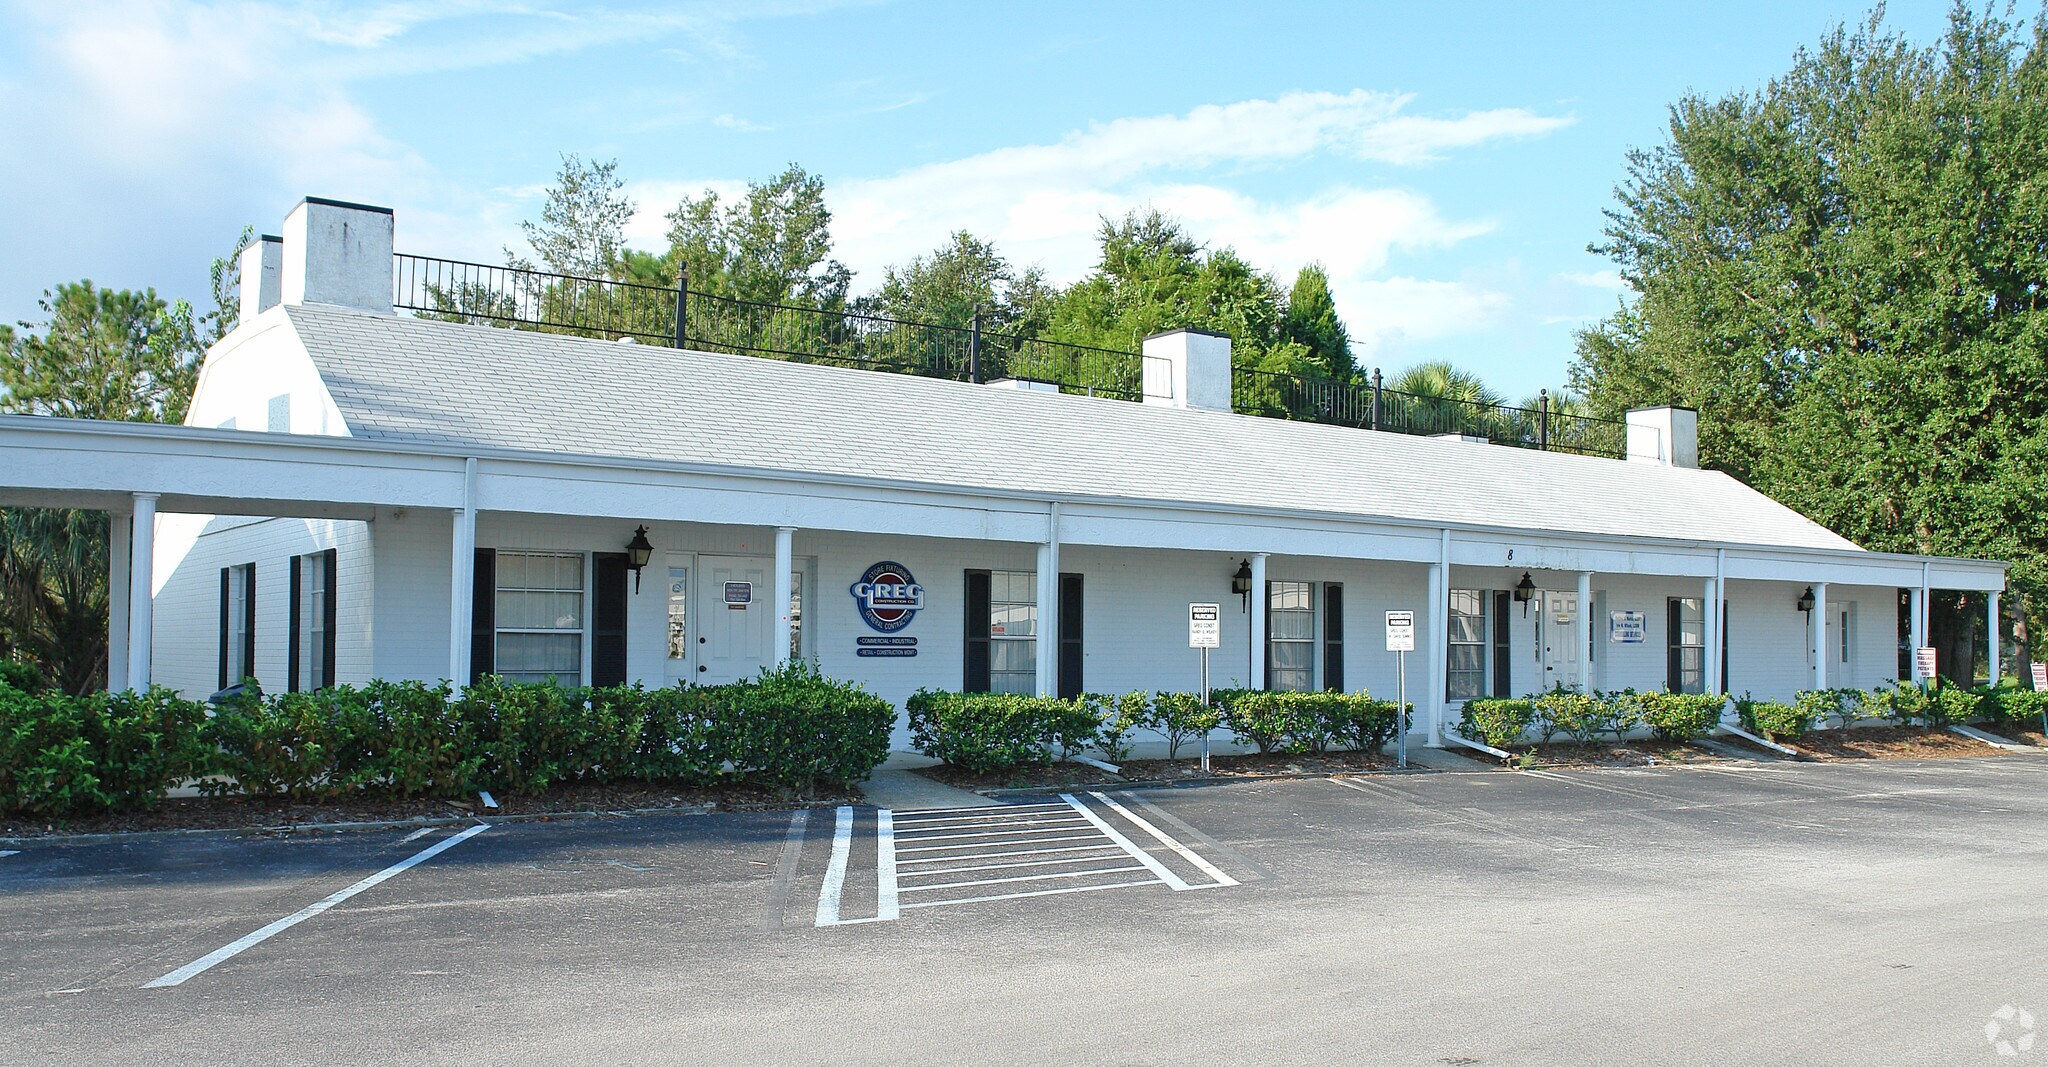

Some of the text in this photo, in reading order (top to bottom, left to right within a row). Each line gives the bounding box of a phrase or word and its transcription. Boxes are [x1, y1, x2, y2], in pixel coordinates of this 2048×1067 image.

[1507, 549, 1514, 561] 8
[868, 564, 912, 581] STORE FIXTURING
[854, 582, 924, 609] GREG
[865, 610, 913, 630] GENERAL CONTRACTING
